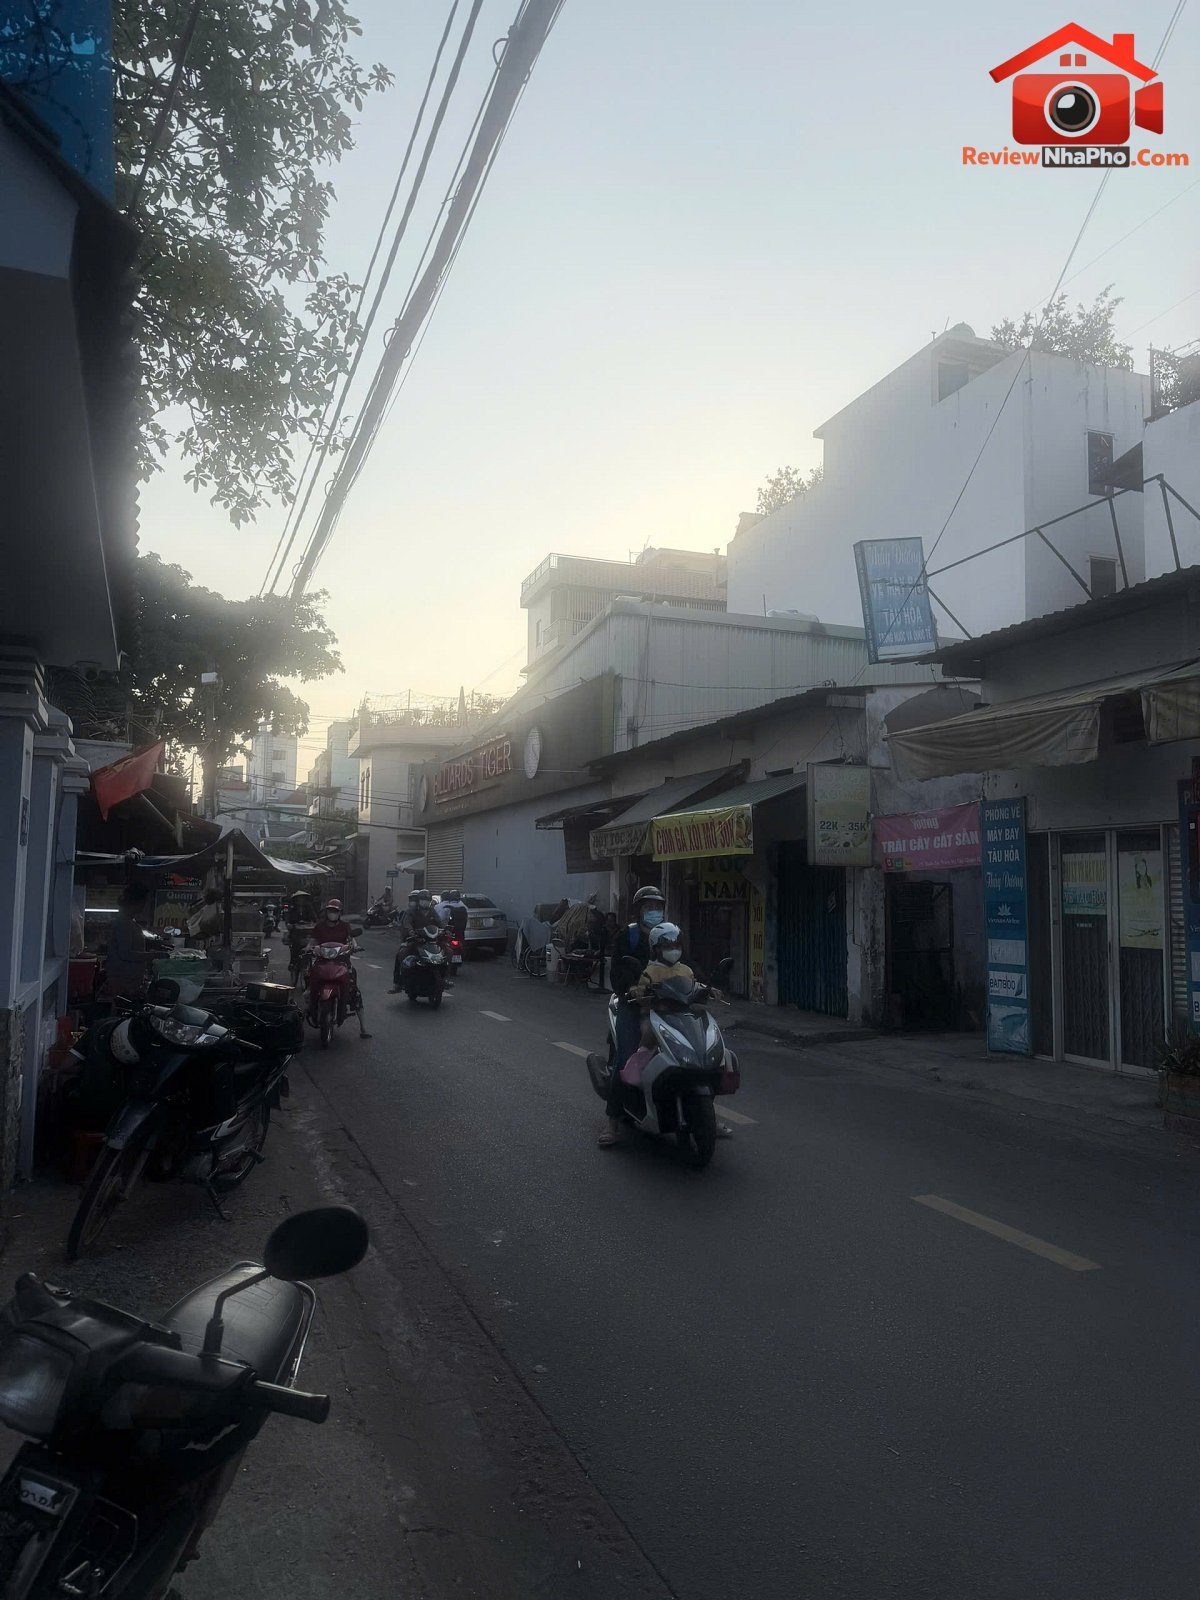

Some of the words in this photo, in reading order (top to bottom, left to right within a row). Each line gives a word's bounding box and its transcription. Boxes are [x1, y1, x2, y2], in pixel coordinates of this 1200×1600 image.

[480, 740, 511, 779] TIGER
[820, 820, 838, 830] 22K
[848, 822, 867, 831] 35K
[1004, 827, 1020, 841] BAY
[704, 879, 748, 899] NAM
